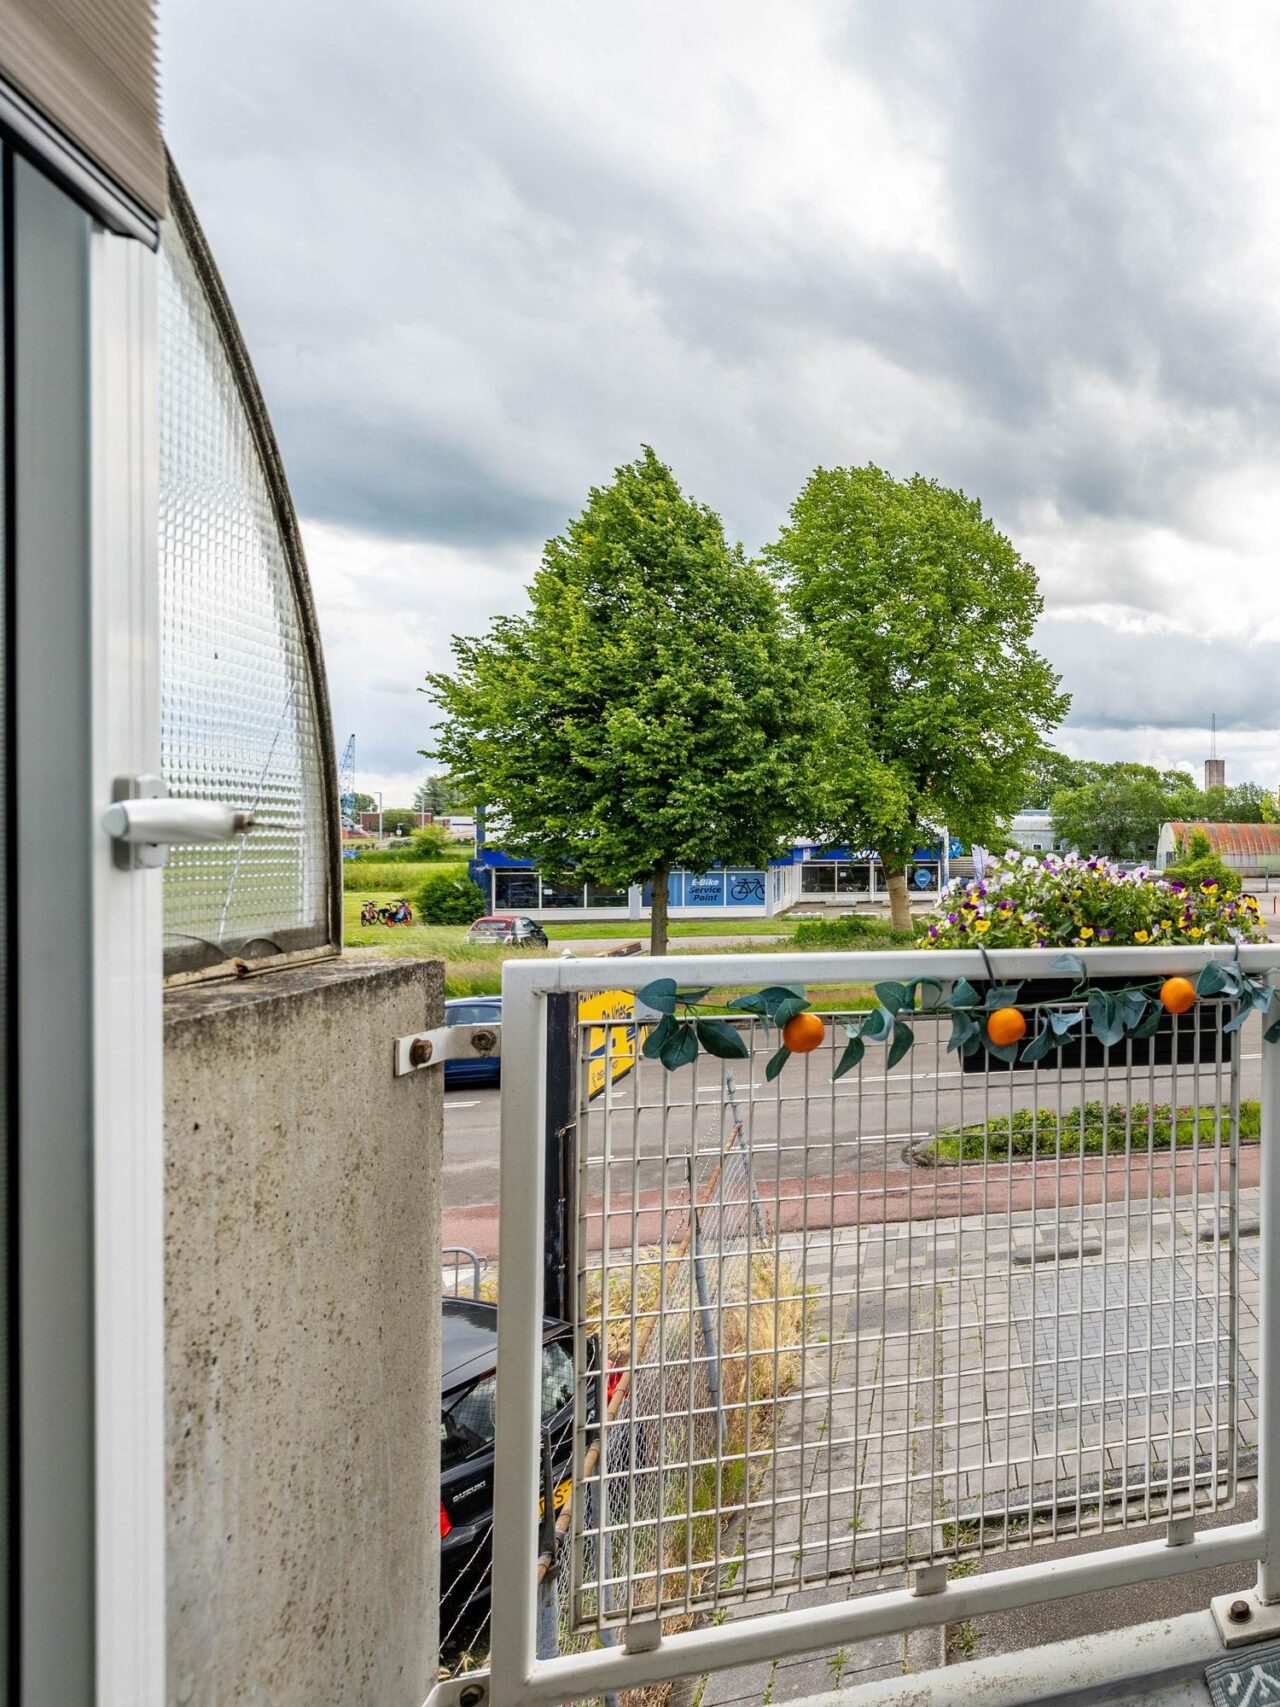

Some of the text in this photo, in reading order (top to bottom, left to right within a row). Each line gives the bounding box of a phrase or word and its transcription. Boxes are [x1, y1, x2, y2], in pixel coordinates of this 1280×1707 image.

[691, 878, 720, 886] E-Bike
[689, 886, 722, 894] Service
[693, 894, 718, 902] Point
[452, 1480, 486, 1503] SUZUKI
